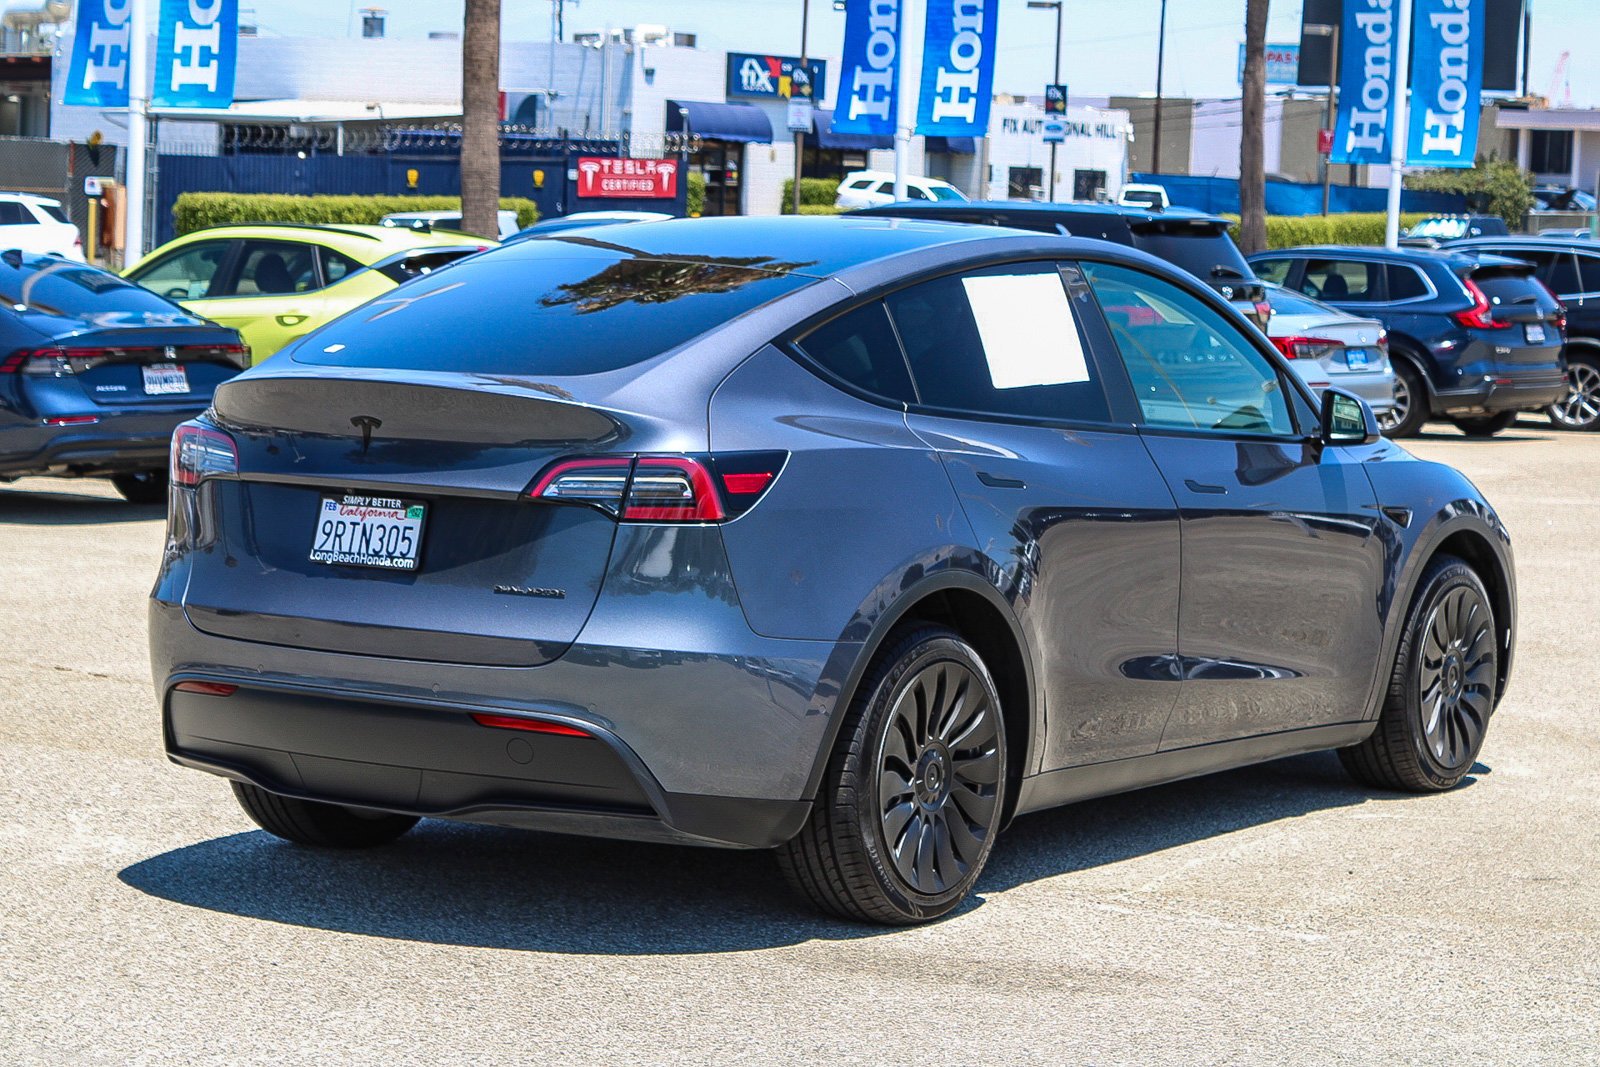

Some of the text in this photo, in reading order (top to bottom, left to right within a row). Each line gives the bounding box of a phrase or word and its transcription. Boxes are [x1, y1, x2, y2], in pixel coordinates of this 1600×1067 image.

[1022, 120, 1044, 134] AUT
[601, 159, 657, 175] TESLA
[342, 495, 402, 508] SIMPLY BETTER
[339, 504, 405, 522] California
[318, 520, 413, 558] 9RTN305
[309, 549, 414, 568] LongBeachHonda.com
